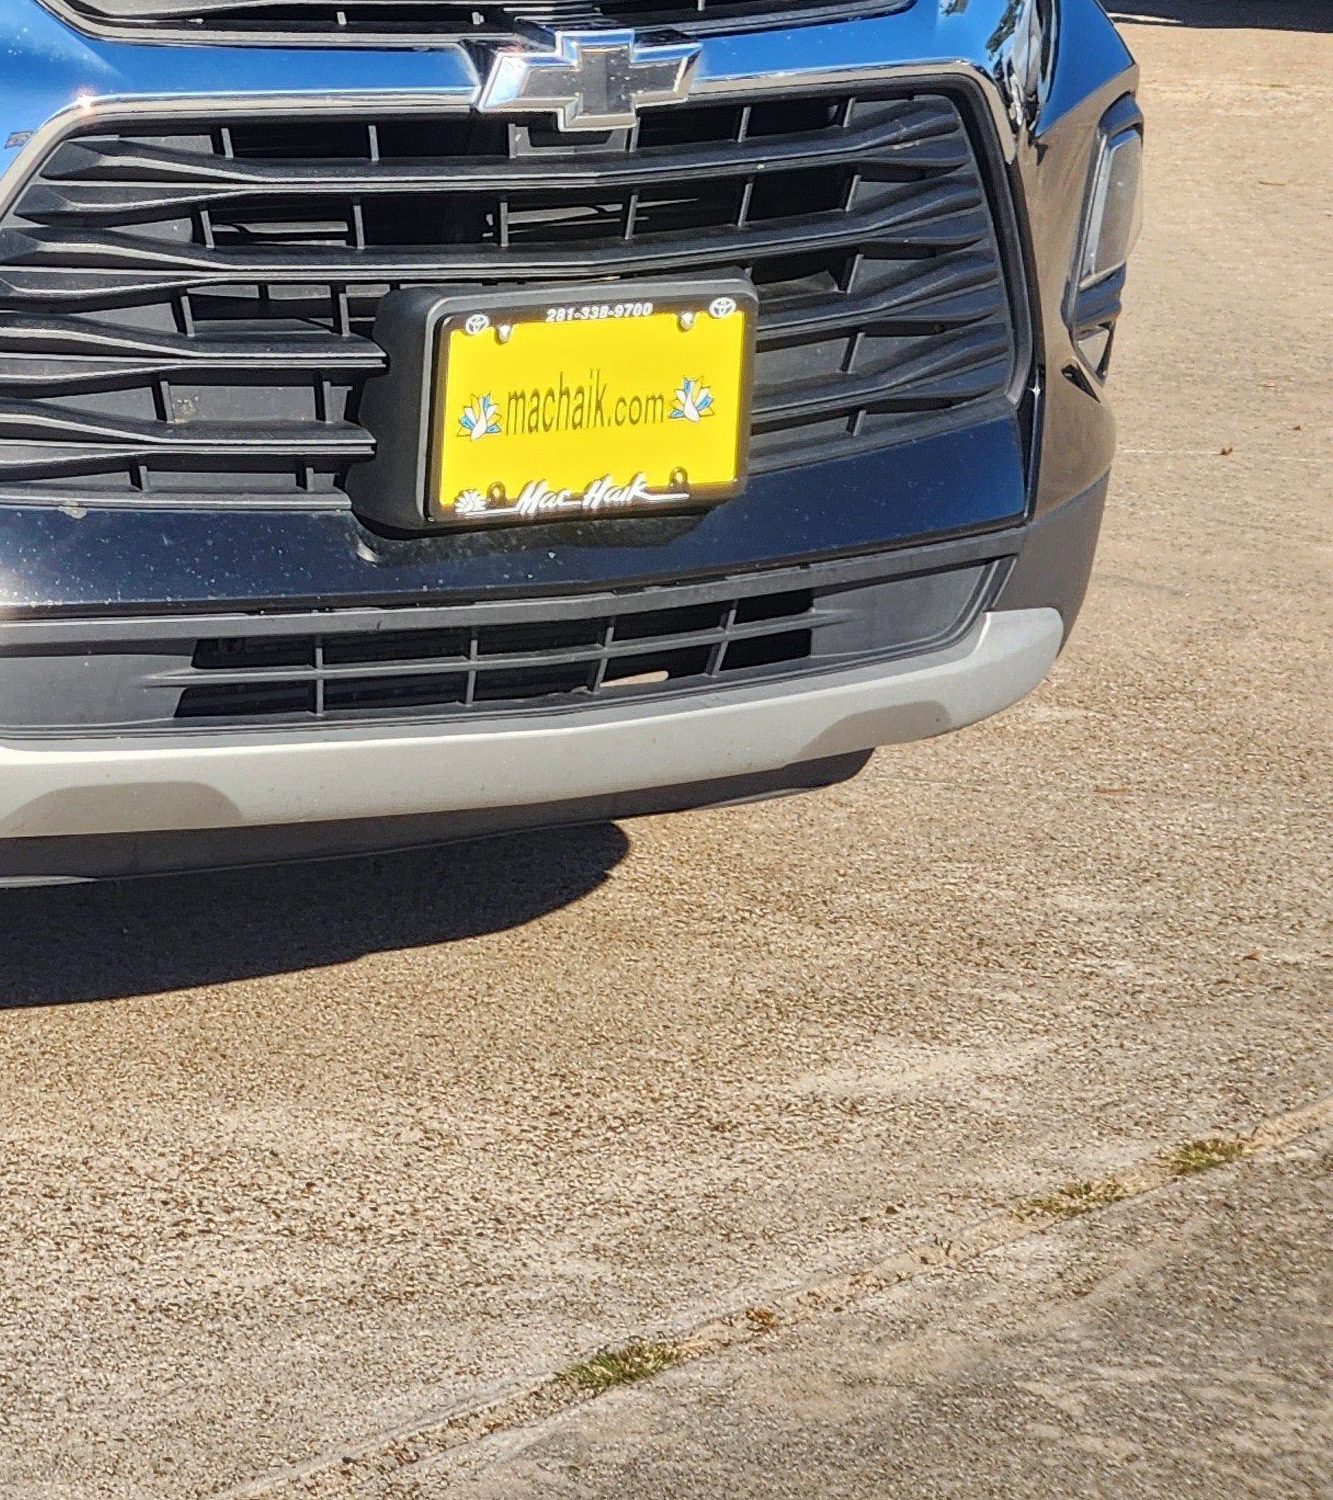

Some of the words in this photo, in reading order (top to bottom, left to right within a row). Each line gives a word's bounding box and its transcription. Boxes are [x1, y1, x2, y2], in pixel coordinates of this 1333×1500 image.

[505, 368, 666, 436] machaik.com
[511, 478, 580, 517] Mac
[582, 471, 668, 512] Haik
